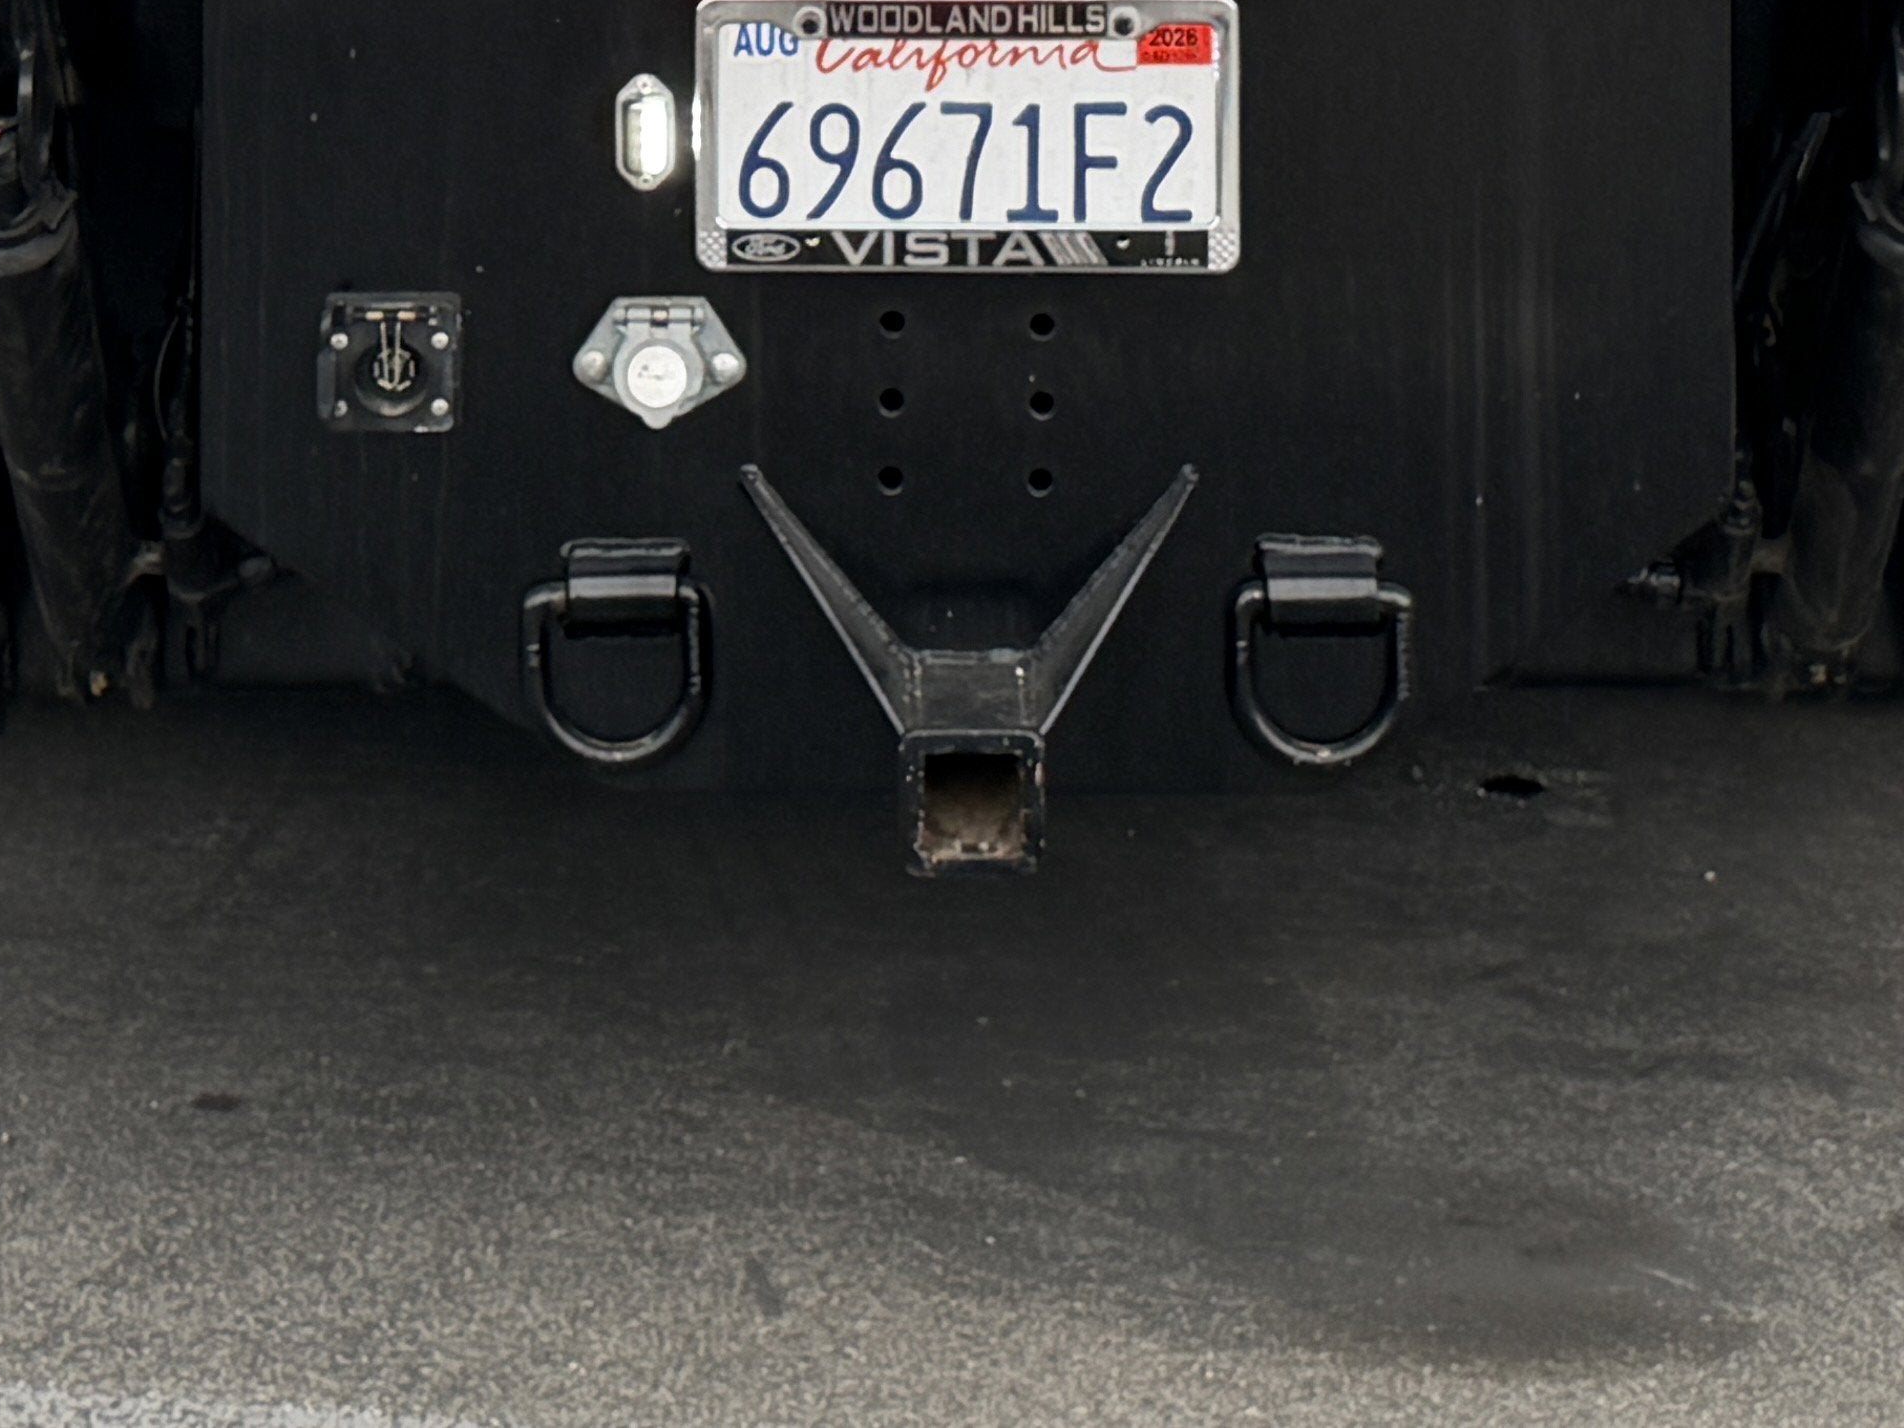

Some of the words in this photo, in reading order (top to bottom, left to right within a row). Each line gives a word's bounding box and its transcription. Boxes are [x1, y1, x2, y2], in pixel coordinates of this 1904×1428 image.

[830, 4, 1012, 34] WOODLAND
[1018, 4, 1105, 34] HILLS
[733, 23, 798, 57] AUG
[1149, 28, 1198, 47] 2026
[815, 38, 1137, 92] California
[737, 101, 1193, 222] 69671F2
[831, 229, 1045, 265] VISTA
